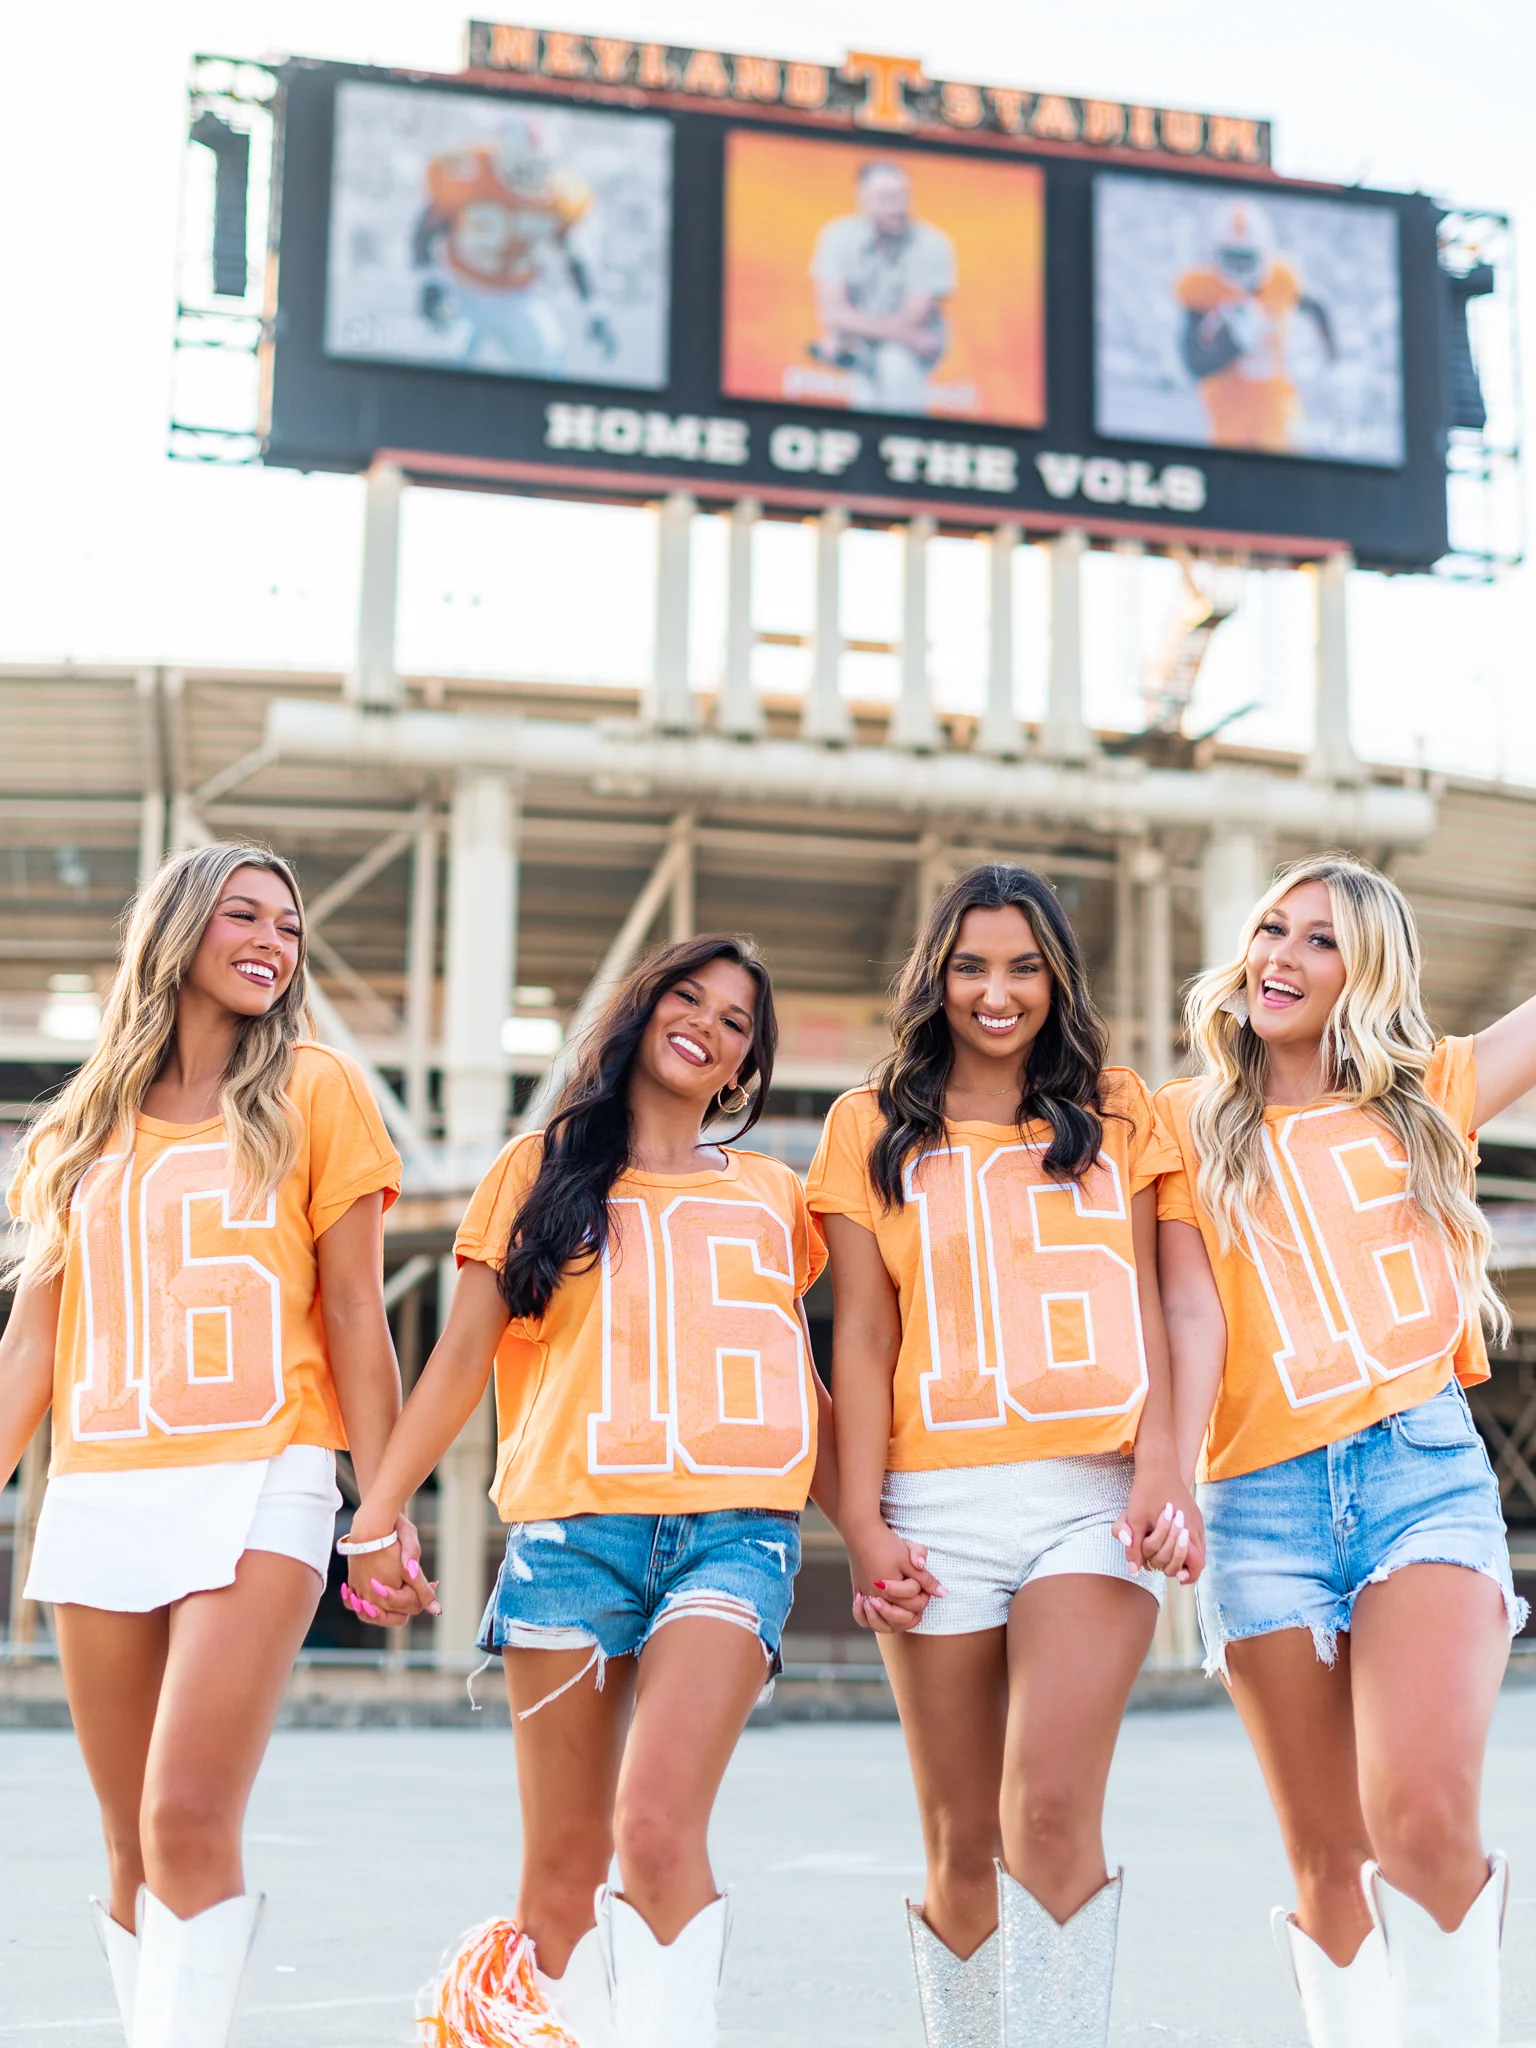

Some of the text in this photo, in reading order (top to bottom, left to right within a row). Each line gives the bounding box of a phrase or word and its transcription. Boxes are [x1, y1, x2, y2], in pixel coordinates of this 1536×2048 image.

[488, 22, 1263, 164] NEYLAND T STADIUM
[545, 401, 1206, 512] HOME OF THE VOLS
[71, 1142, 286, 1442] 16
[588, 1196, 810, 1476] 16
[904, 1142, 1149, 1431] 16
[1233, 1104, 1465, 1409] 16
